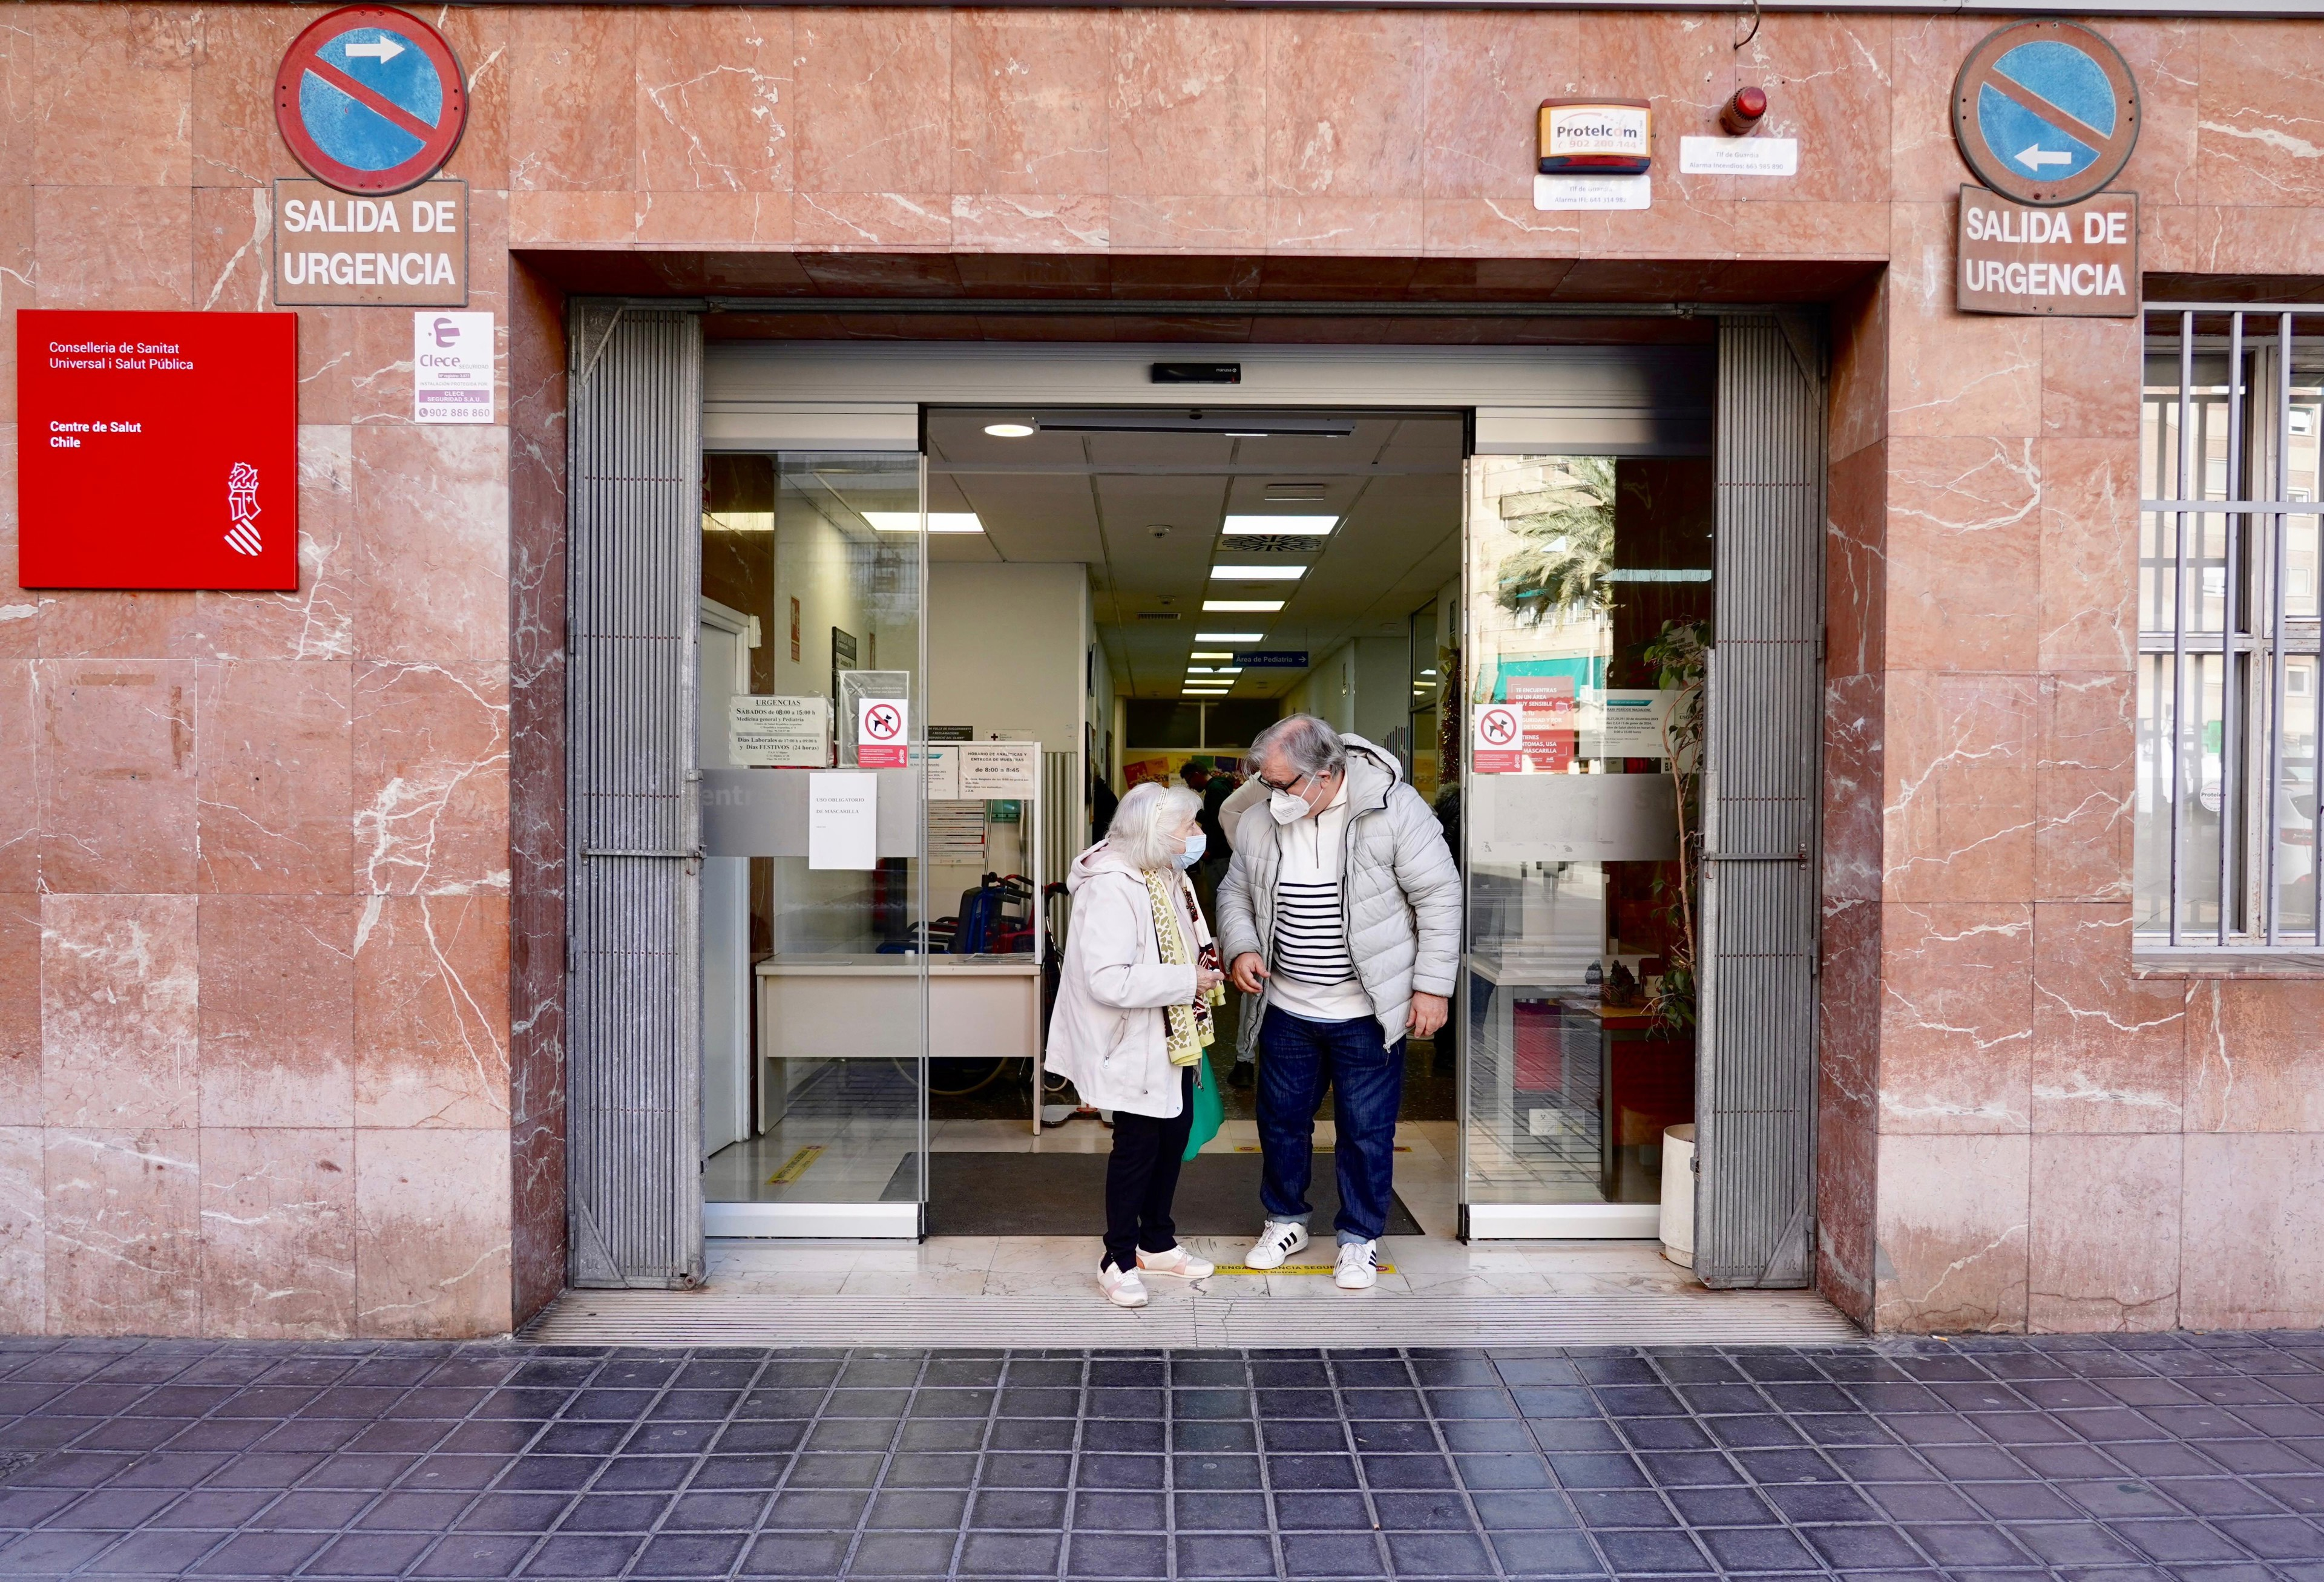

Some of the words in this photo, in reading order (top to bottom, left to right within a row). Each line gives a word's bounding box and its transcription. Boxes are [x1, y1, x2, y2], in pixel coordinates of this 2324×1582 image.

[1557, 125, 1637, 138] Protelcom
[1618, 140, 1636, 149] 144
[284, 199, 400, 233] SALIDA
[413, 201, 456, 232] DE
[1967, 208, 2071, 243] SALIDA
[2084, 213, 2126, 243] DE
[284, 251, 455, 285] URGENCIA
[1966, 260, 2125, 296] URGENCIA
[50, 342, 116, 353] Conselleria
[119, 342, 133, 353] de
[137, 343, 179, 353] Sanitat
[50, 358, 105, 369] Universal
[109, 358, 111, 369] i
[116, 358, 146, 369] Salut
[149, 358, 193, 369] Pública
[421, 354, 460, 367] Clece
[50, 421, 89, 432] Centre
[93, 421, 107, 432] de
[110, 422, 141, 432] Salut
[50, 437, 80, 447] Chile
